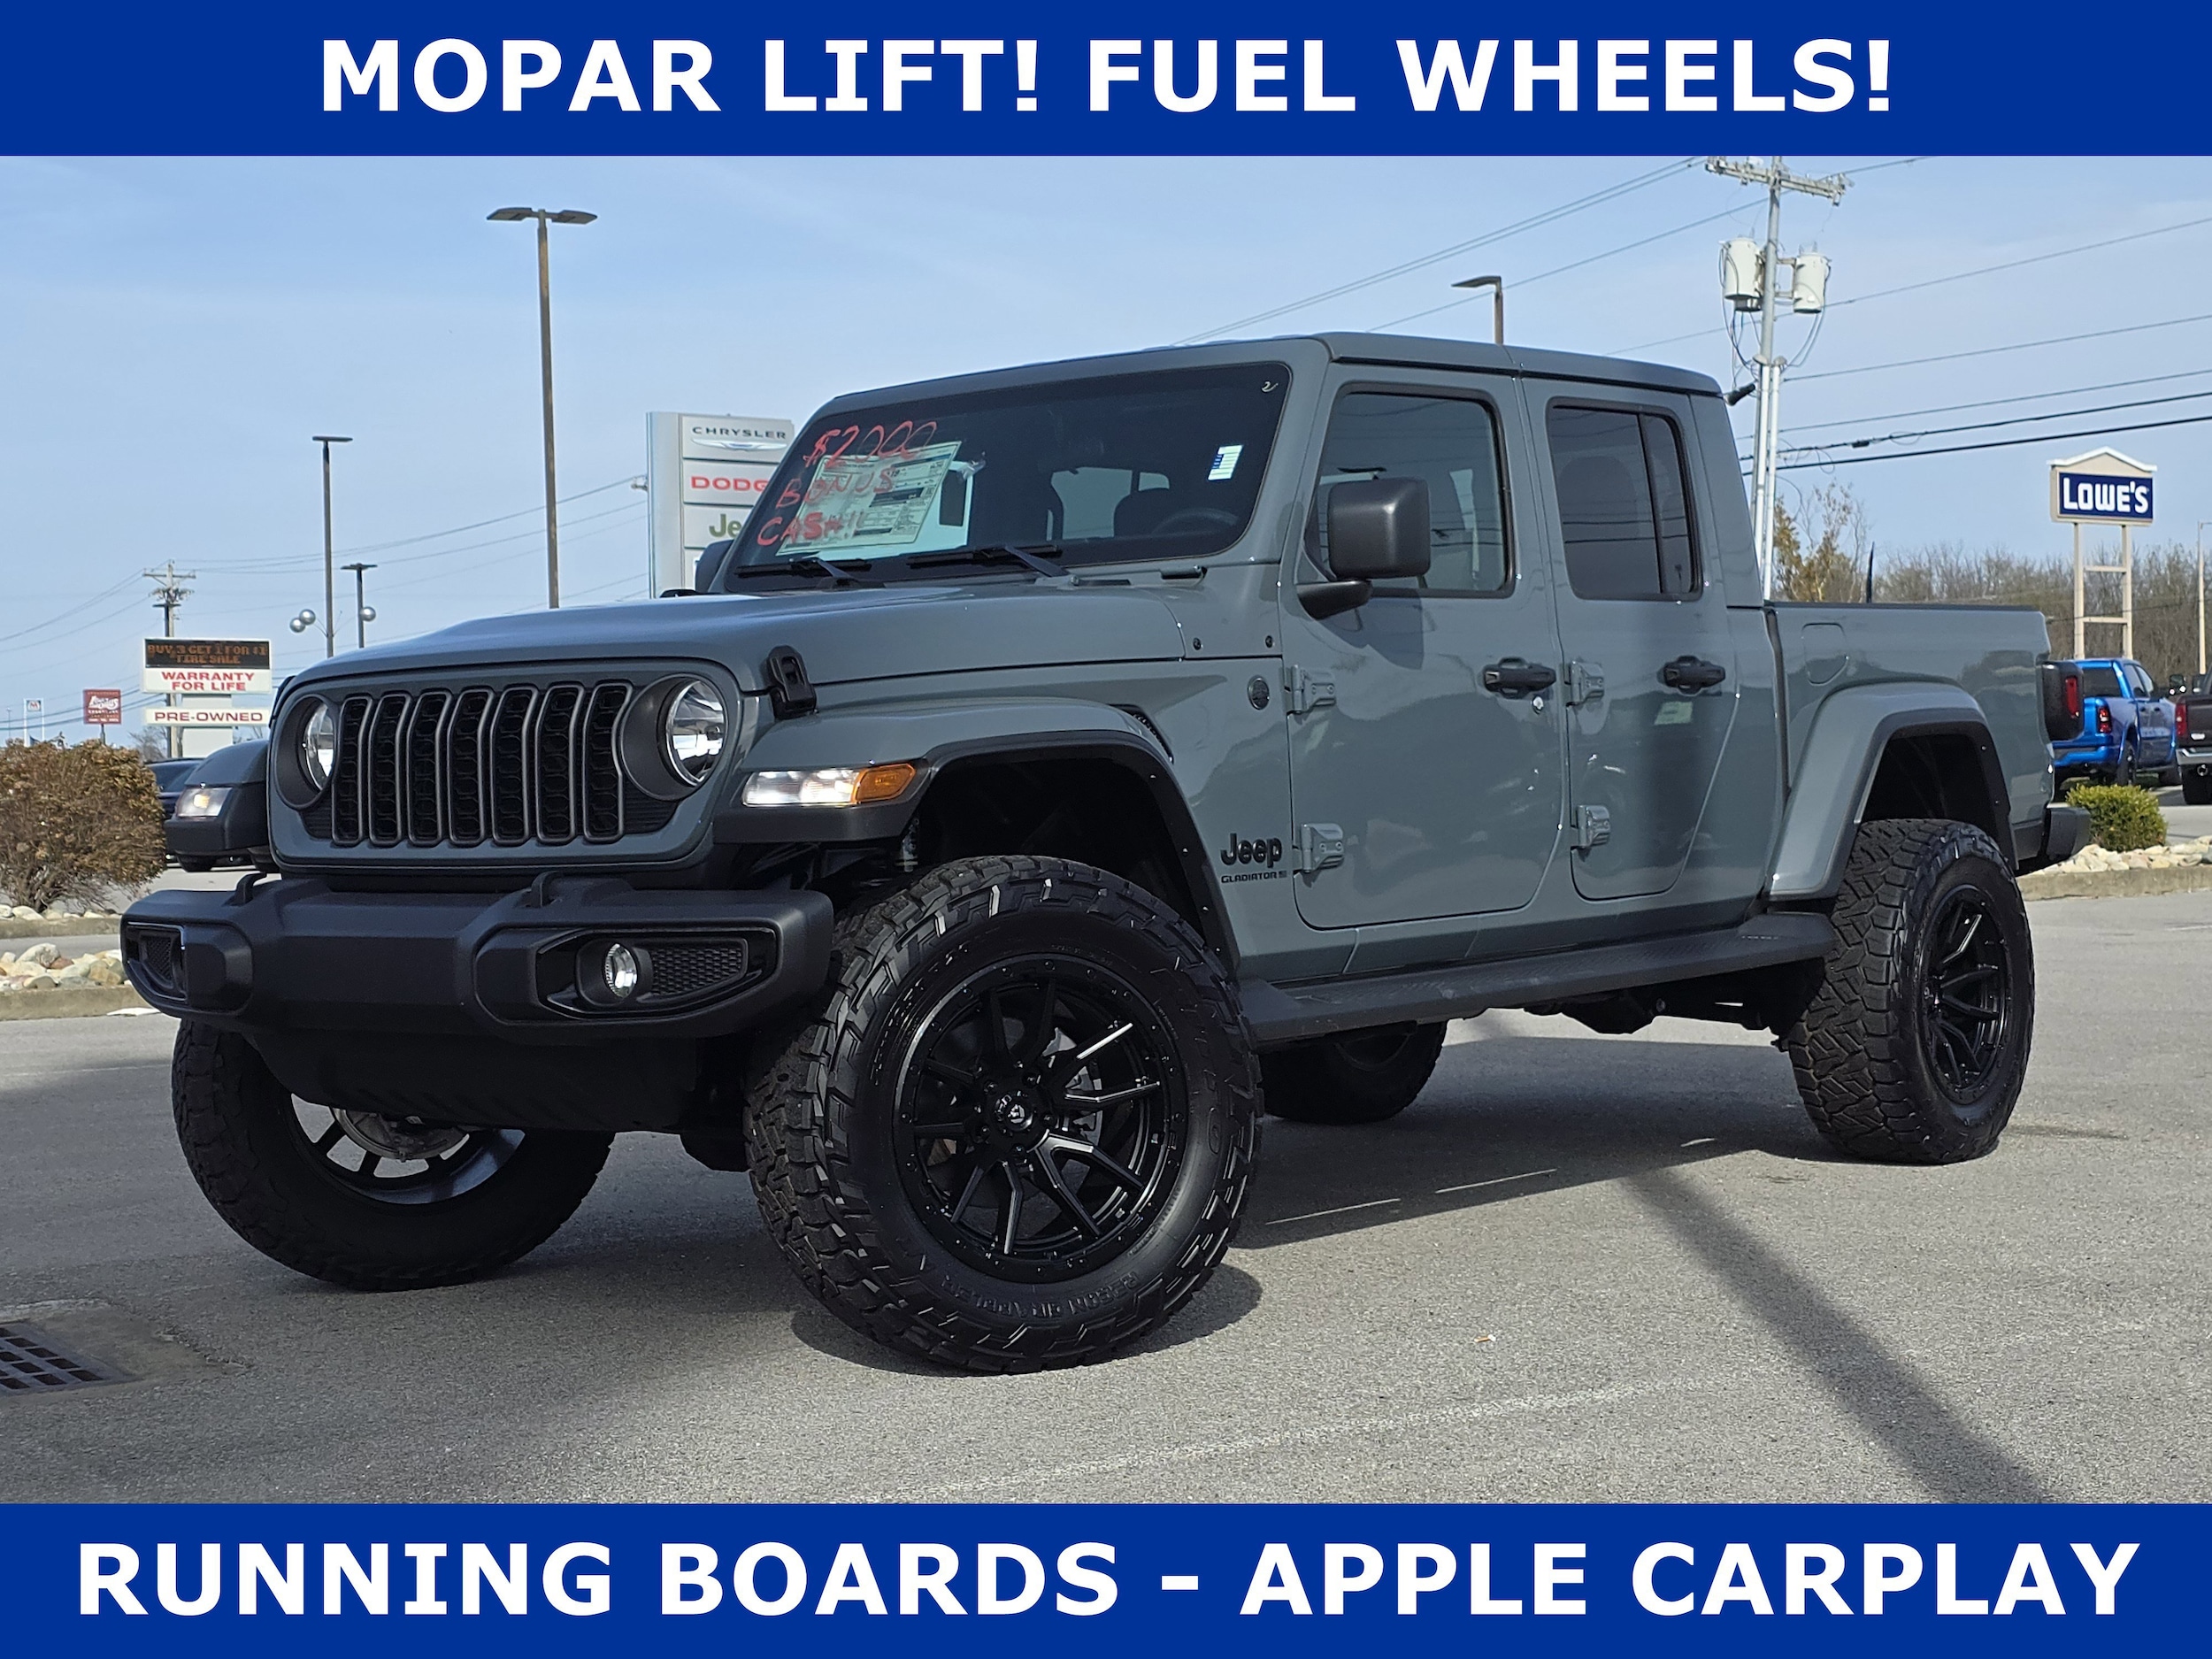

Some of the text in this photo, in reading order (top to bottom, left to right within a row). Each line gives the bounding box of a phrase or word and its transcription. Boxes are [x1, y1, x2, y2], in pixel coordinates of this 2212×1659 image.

[692, 426, 787, 439] CHRYSLER
[691, 476, 768, 492] DODG
[2063, 477, 2149, 514] LOWE'S
[710, 514, 742, 538] Je
[161, 672, 255, 681] WARRANTY
[172, 681, 247, 691] FOR LIFE
[154, 711, 263, 722] PRE-OWNED
[1220, 833, 1282, 868] Jeep
[1221, 871, 1277, 883] GLADIATOR
